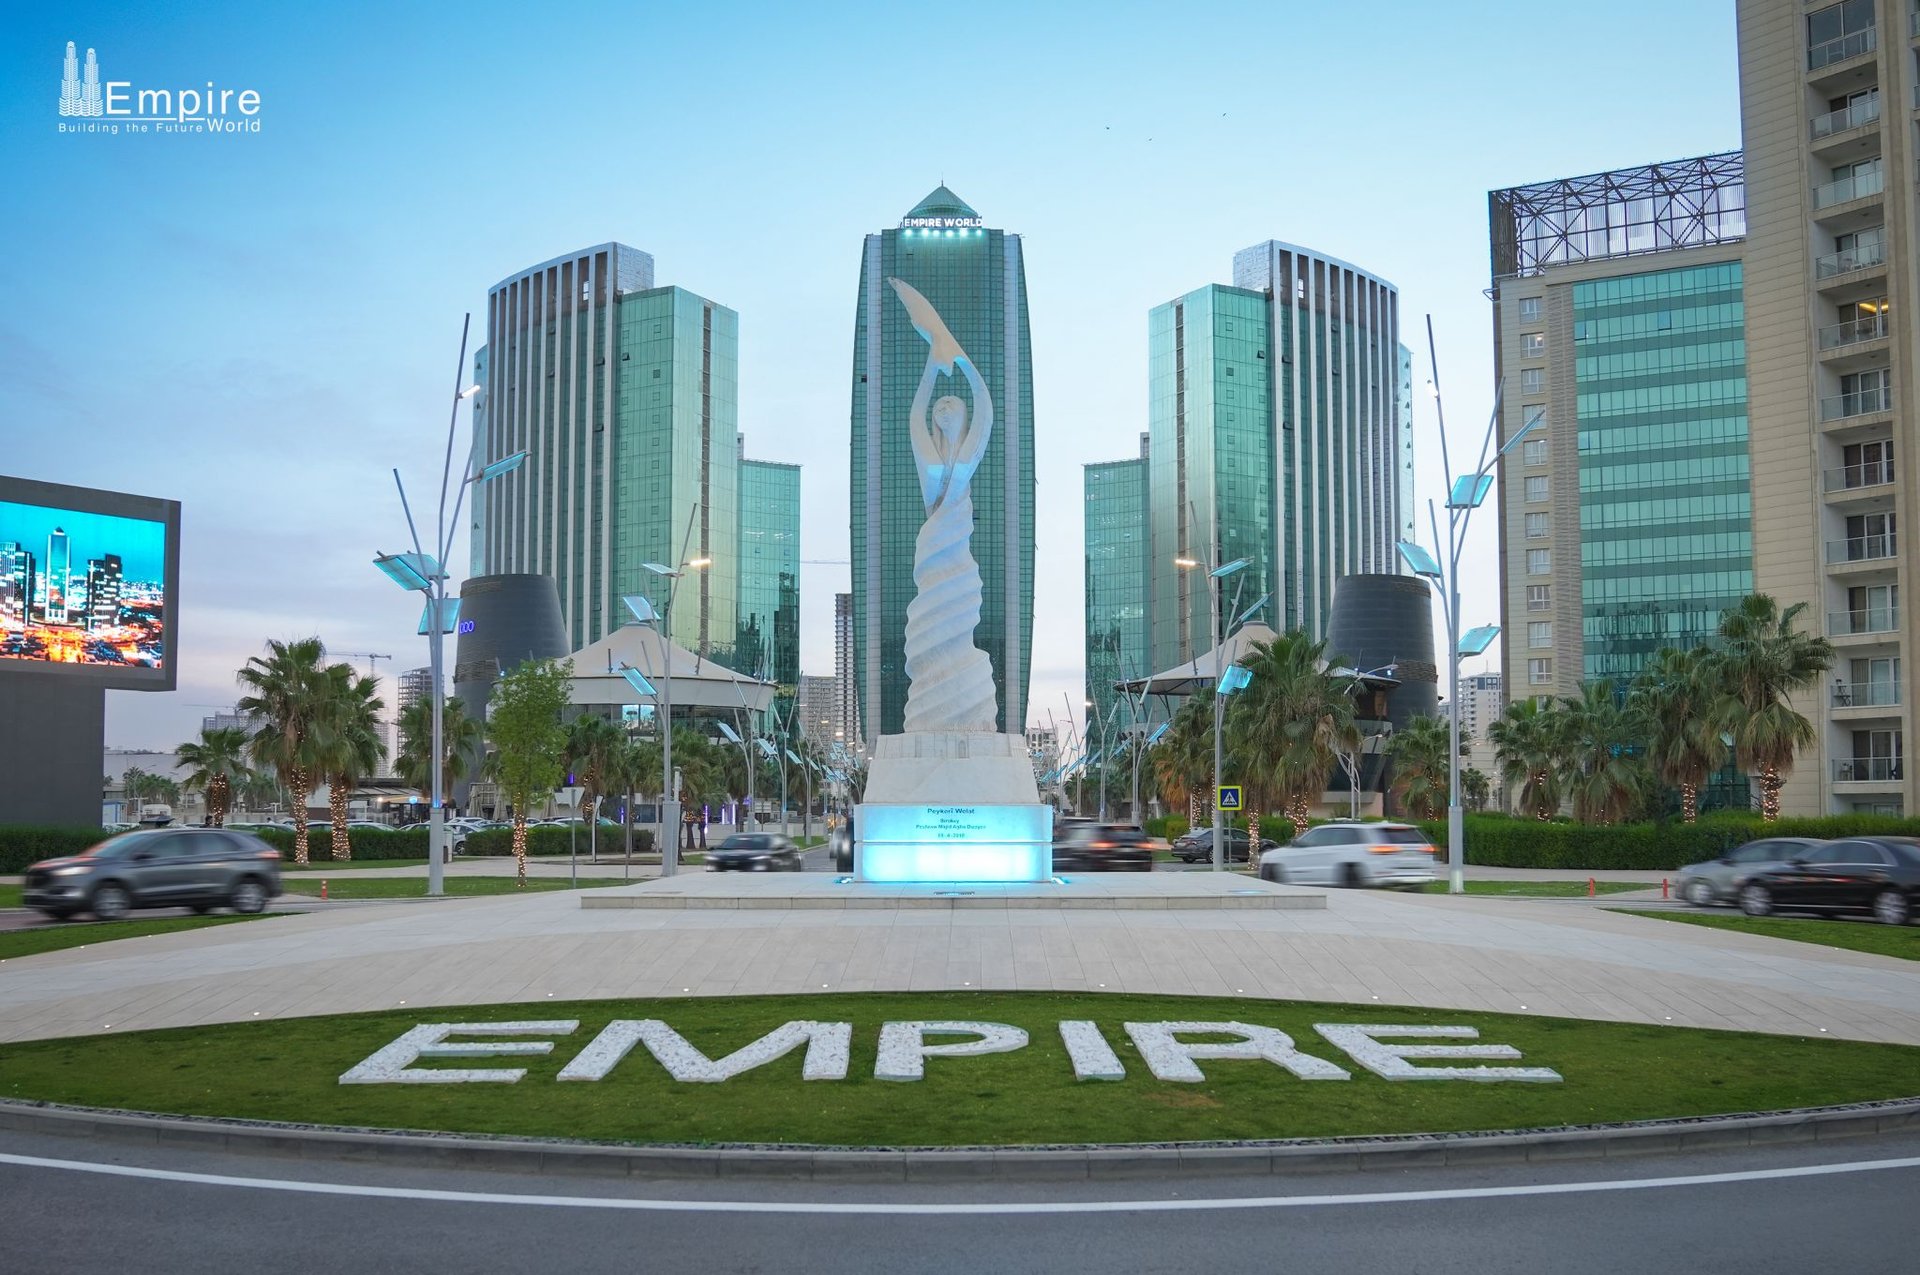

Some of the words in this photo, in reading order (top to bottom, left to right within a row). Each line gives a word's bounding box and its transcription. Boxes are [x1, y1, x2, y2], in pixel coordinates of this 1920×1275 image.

[904, 218, 942, 227] EMPIRE
[943, 218, 983, 227] WORLD
[338, 1018, 1564, 1084] EMPIRE
